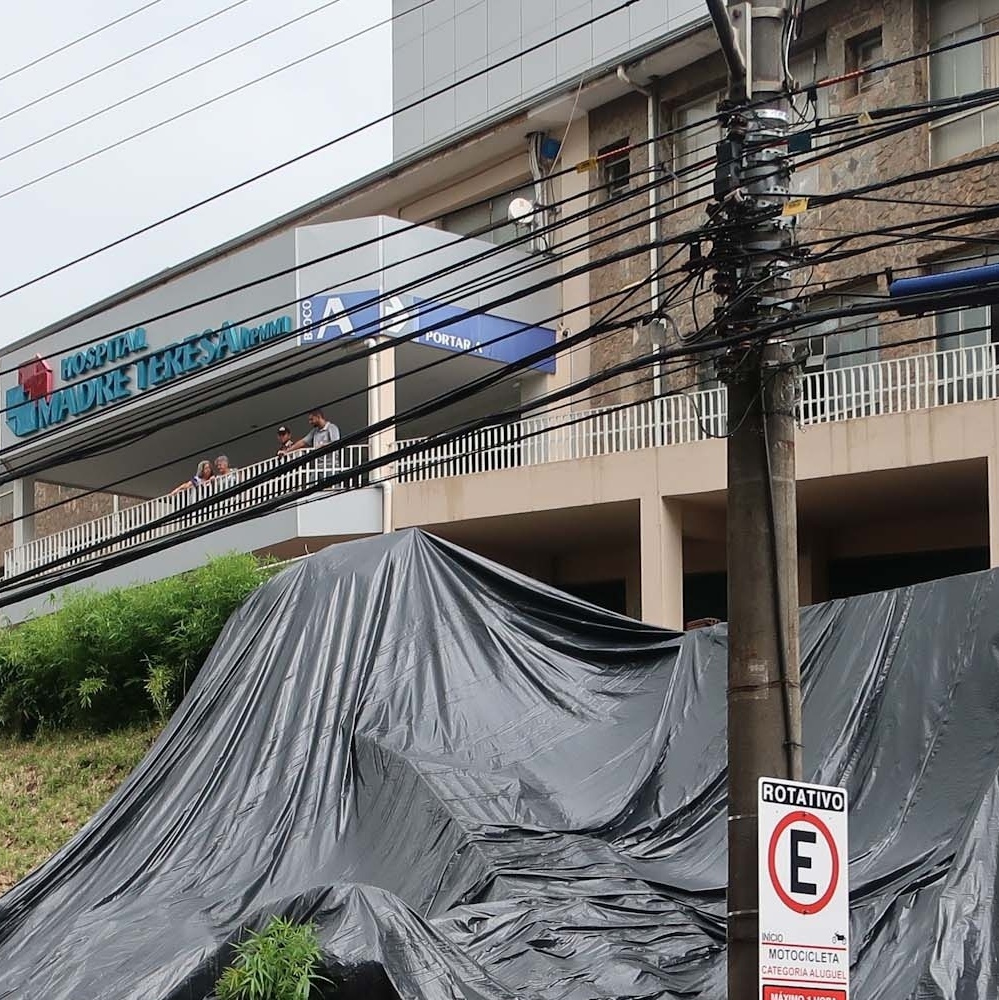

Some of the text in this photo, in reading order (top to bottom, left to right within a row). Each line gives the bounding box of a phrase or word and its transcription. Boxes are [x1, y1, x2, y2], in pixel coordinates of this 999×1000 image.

[302, 300, 313, 340] BOCO
[317, 297, 355, 339] A
[61, 327, 148, 380] HOSPITAL
[425, 331, 483, 353] PORTARA
[38, 365, 131, 429] MADRE
[135, 319, 239, 390] TERESA
[763, 783, 843, 811] ROTATIVO
[790, 829, 817, 896] E
[761, 965, 847, 980] CATEGORIA ALUGUEL
[768, 948, 839, 964] MOTOCICLETA
